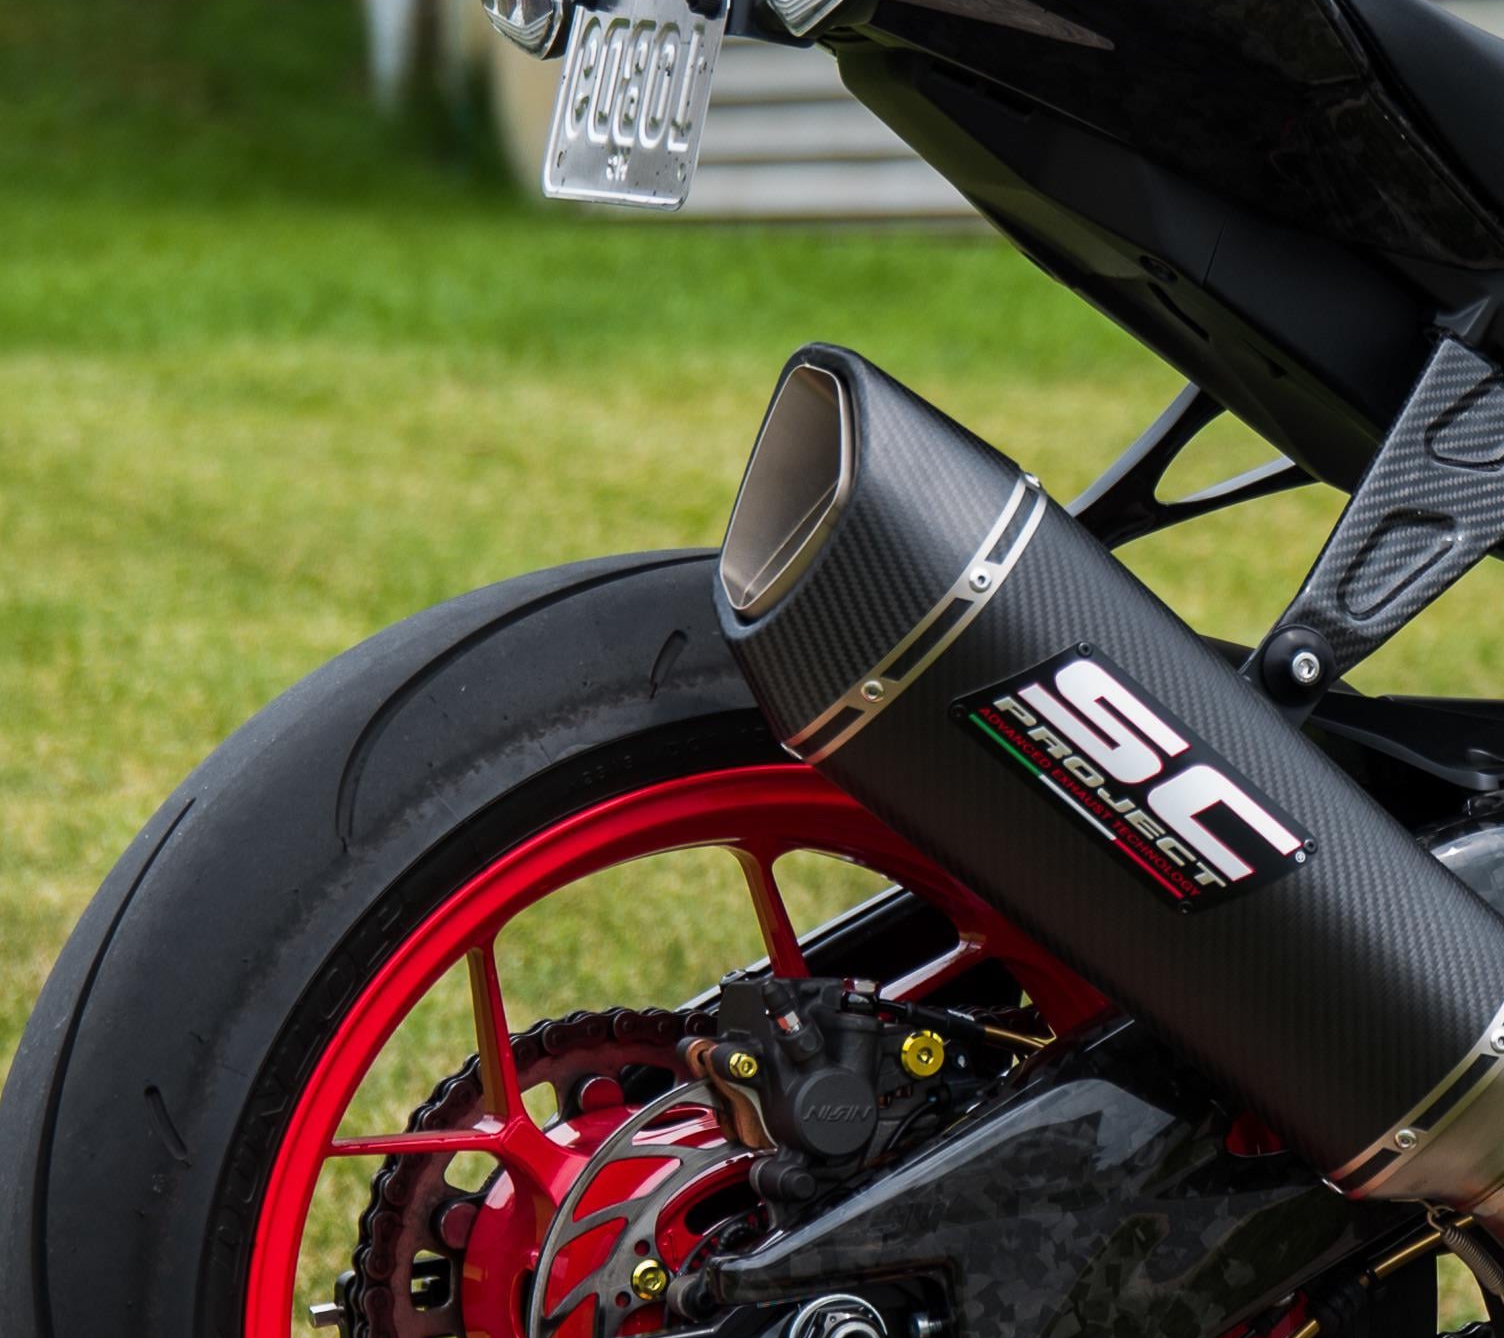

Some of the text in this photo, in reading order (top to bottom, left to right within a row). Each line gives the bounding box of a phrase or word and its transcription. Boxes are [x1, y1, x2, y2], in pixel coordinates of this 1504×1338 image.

[979, 707, 1201, 897] ADVANCED EXHAUST TECHNOLOGY
[993, 696, 1227, 888] PROJECT
[1017, 659, 1304, 883] SC
